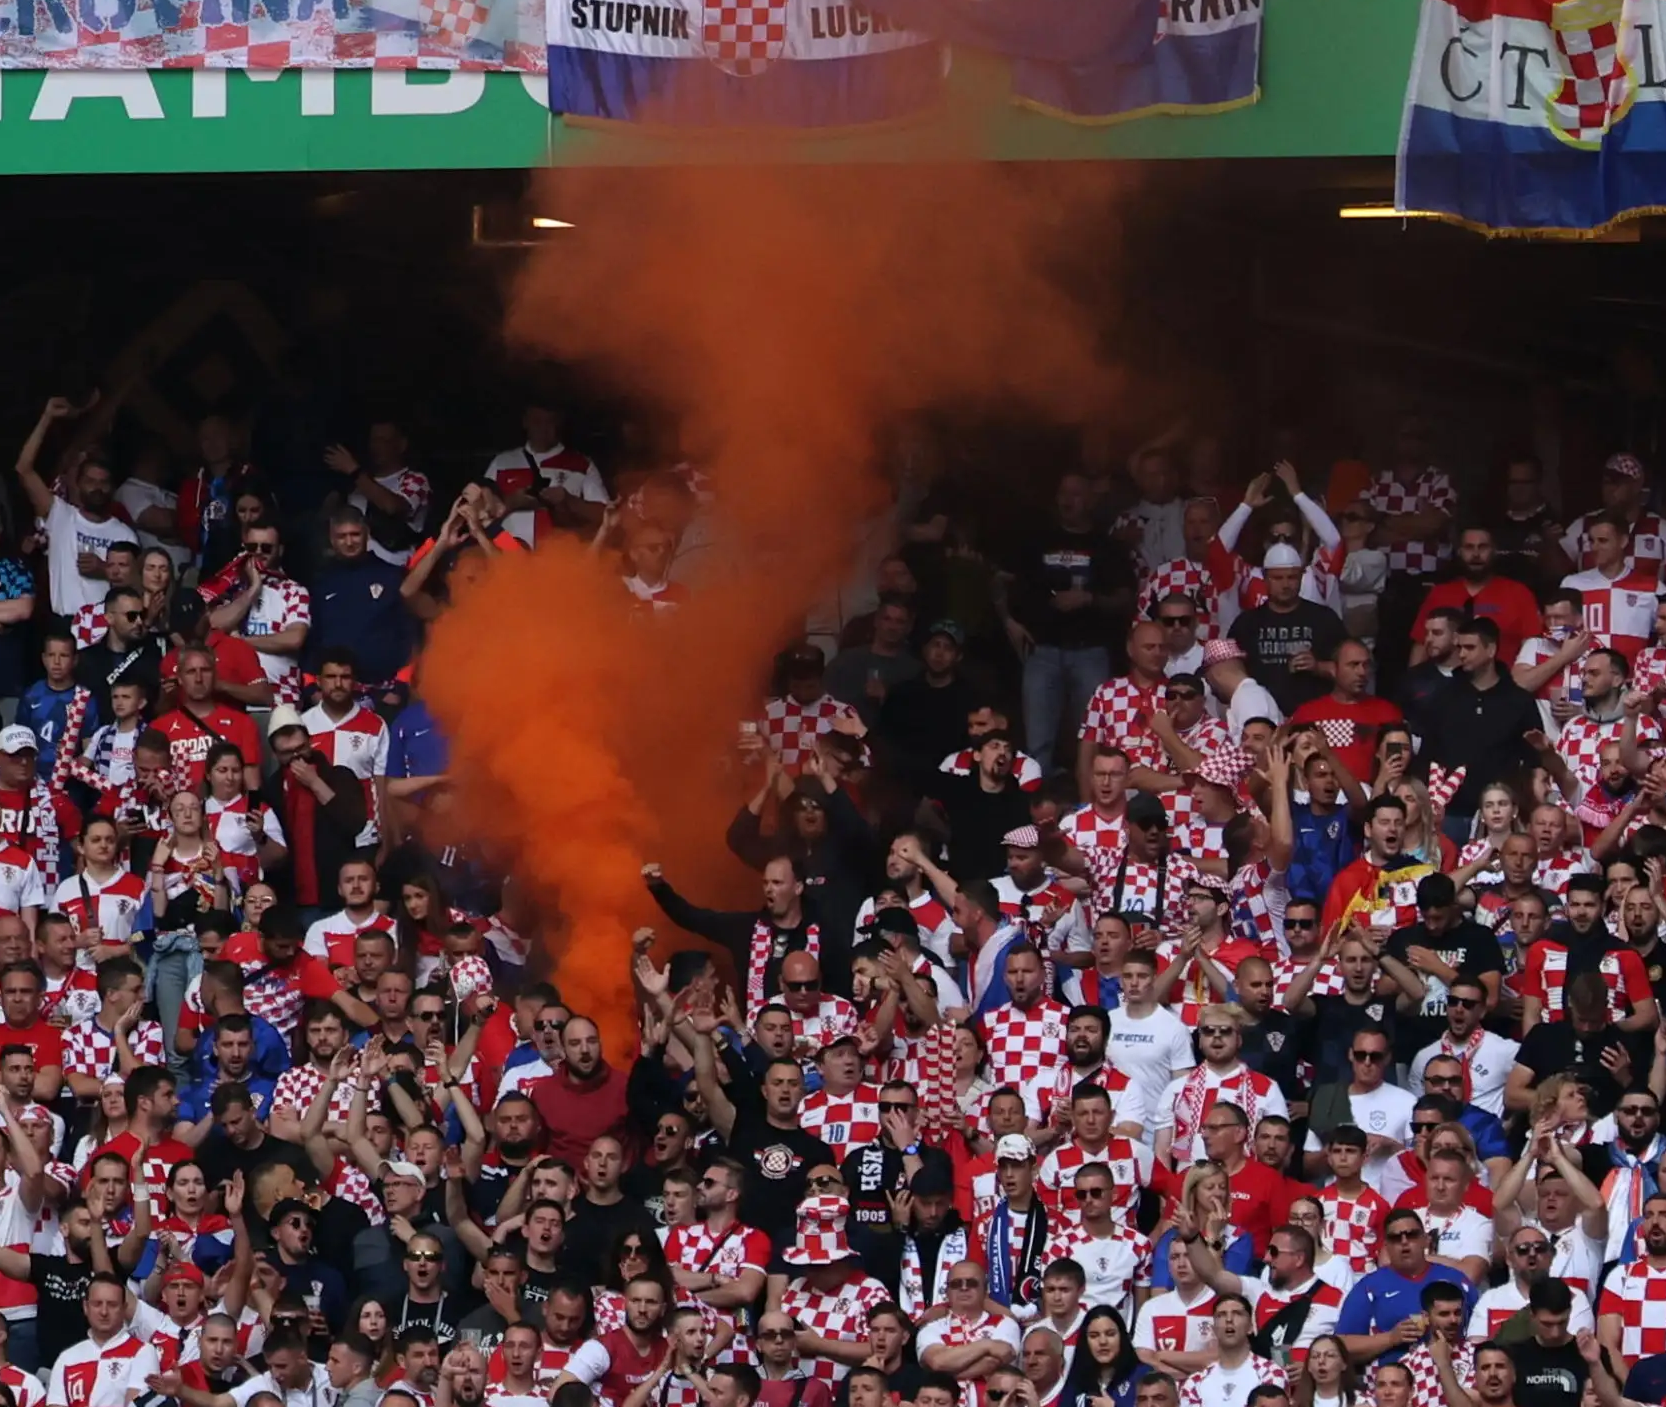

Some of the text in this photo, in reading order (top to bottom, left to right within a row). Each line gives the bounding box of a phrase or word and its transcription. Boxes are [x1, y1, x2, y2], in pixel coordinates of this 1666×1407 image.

[441, 846, 457, 866] 11
[828, 1124, 844, 1142] 10
[855, 1210, 886, 1223] 1905
[1526, 1375, 1561, 1384] NORTH
